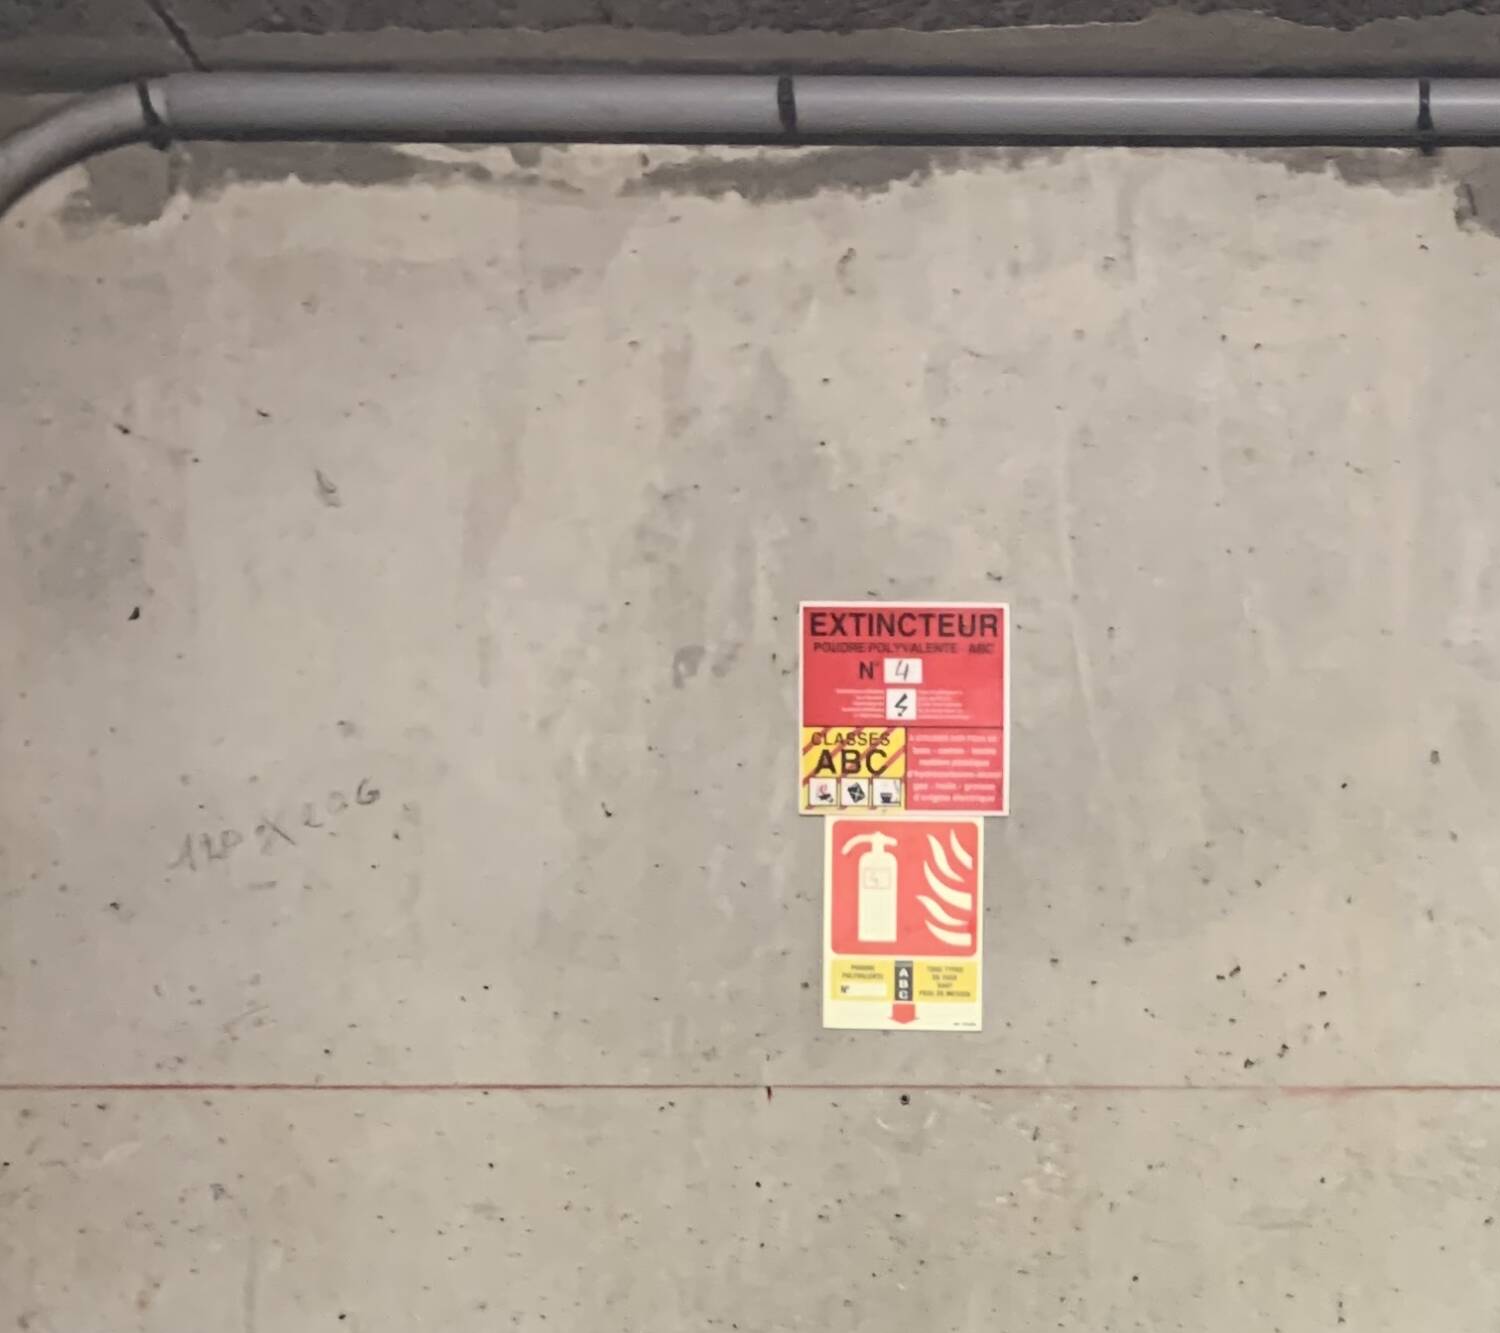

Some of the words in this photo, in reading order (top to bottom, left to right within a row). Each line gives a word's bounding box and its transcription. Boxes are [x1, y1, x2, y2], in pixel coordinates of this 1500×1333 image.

[809, 612, 999, 638] EXTINCTEUR
[813, 642, 864, 654] POUDRE
[894, 660, 909, 681] 4
[811, 731, 891, 746] CLASSES
[815, 748, 888, 775] ABC
